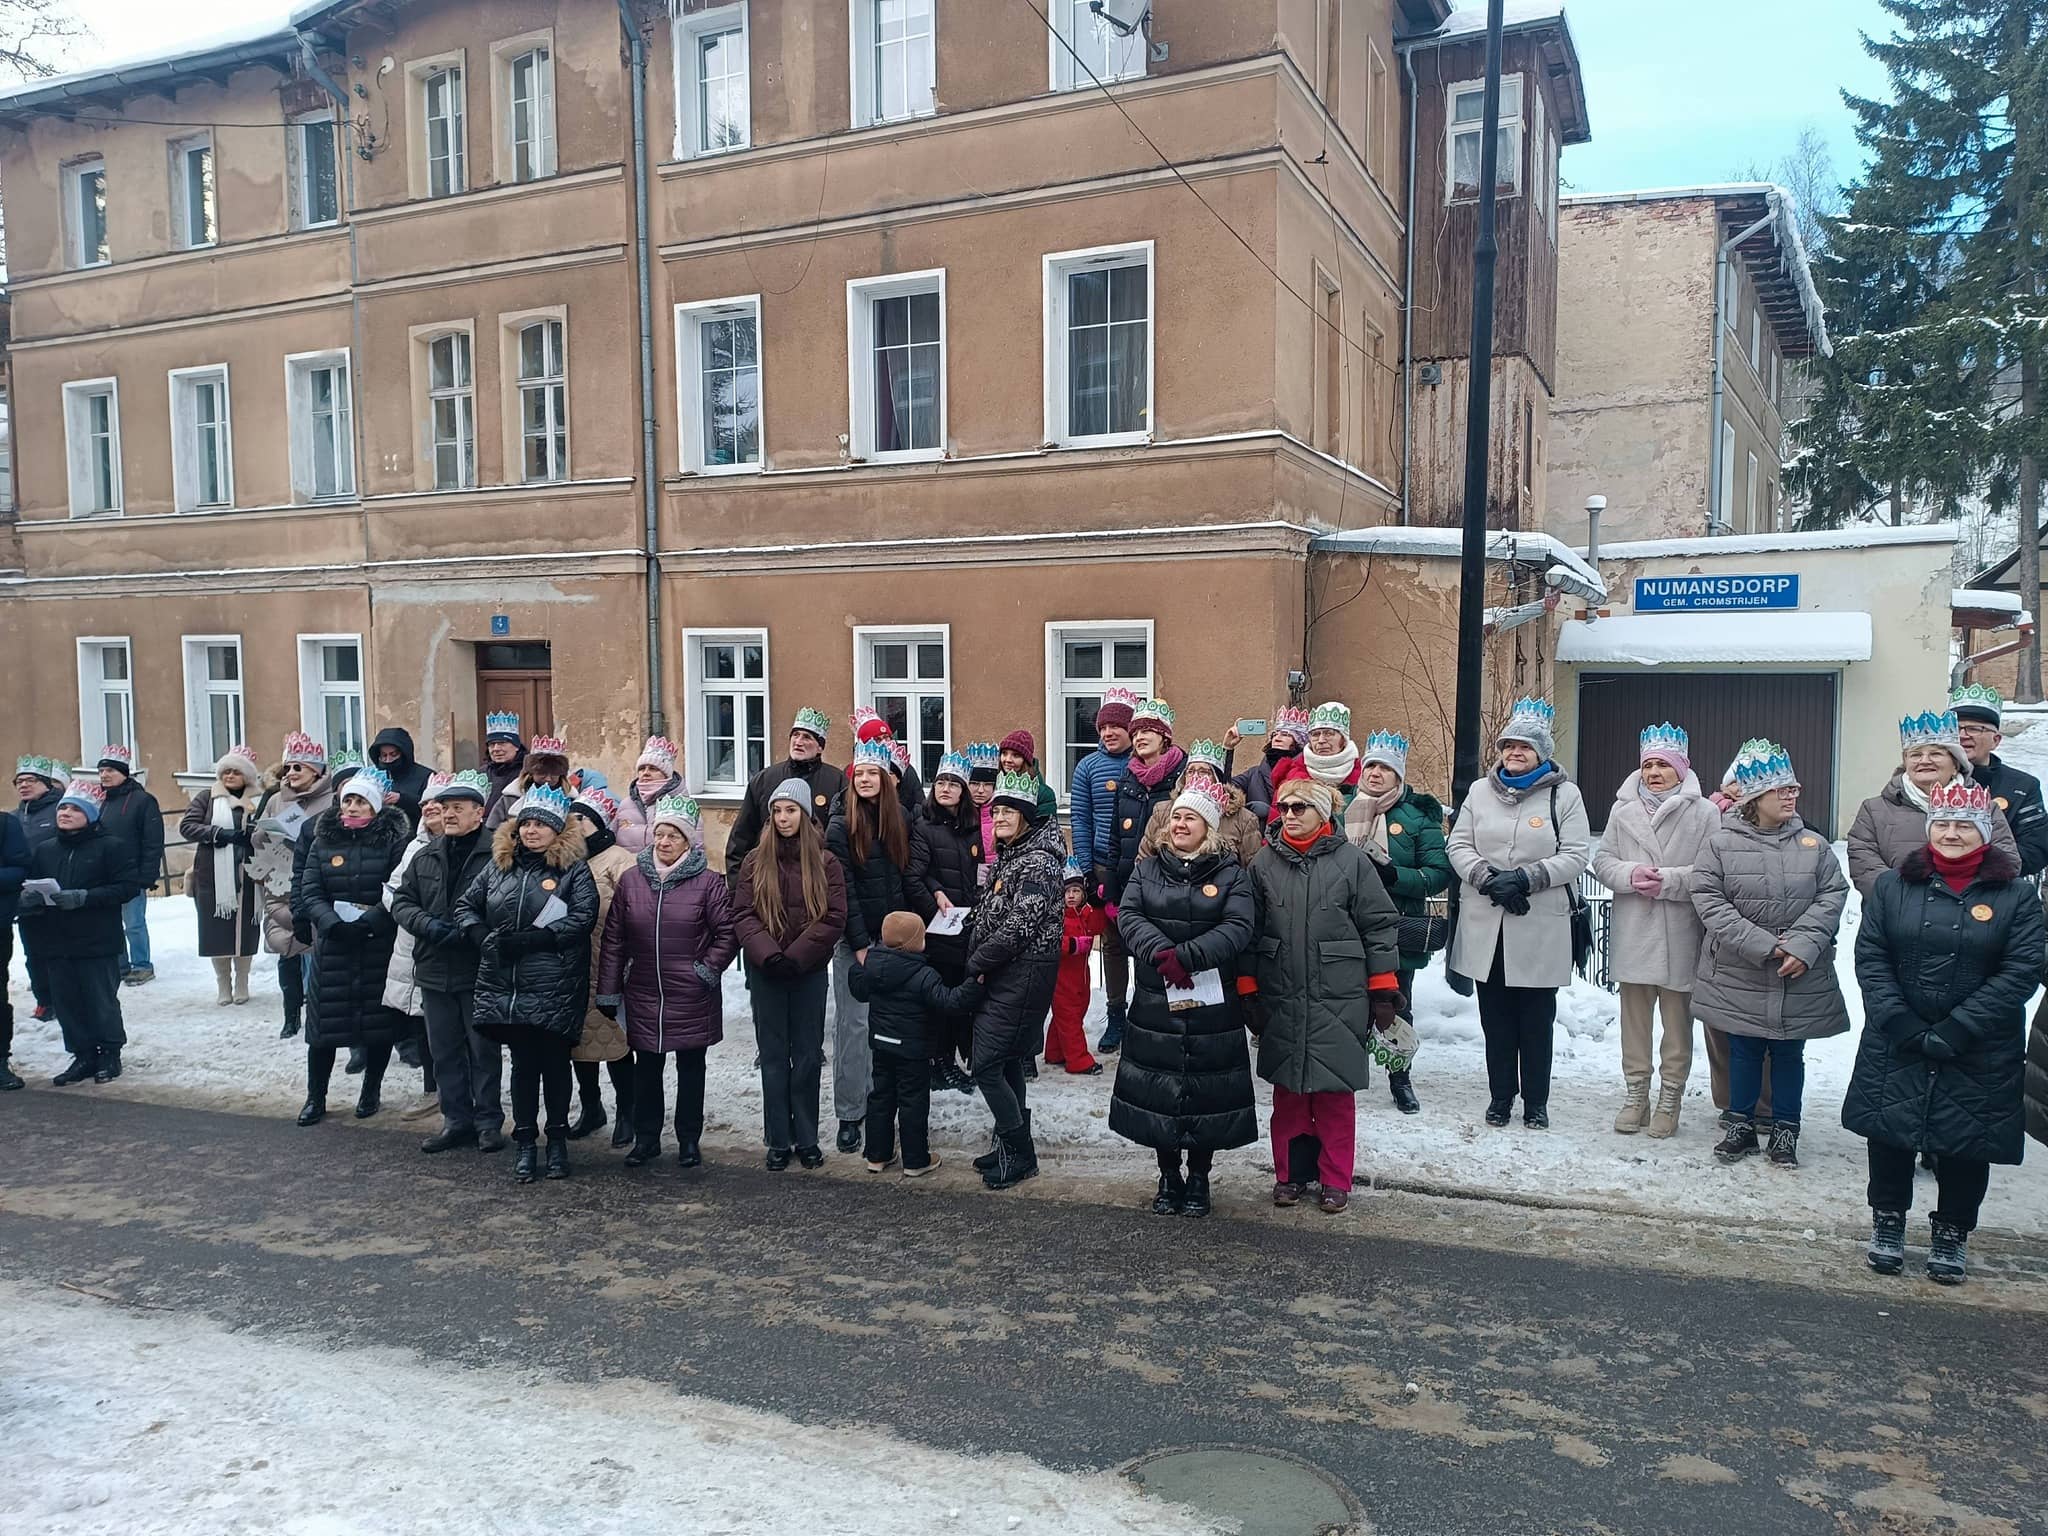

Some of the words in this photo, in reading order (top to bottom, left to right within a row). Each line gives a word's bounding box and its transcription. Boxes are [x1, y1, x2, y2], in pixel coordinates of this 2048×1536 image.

[1643, 578, 1791, 596] NUMANSDORP
[1663, 598, 1689, 607] GEM.
[1694, 596, 1768, 606] CROMSTRIJEN
